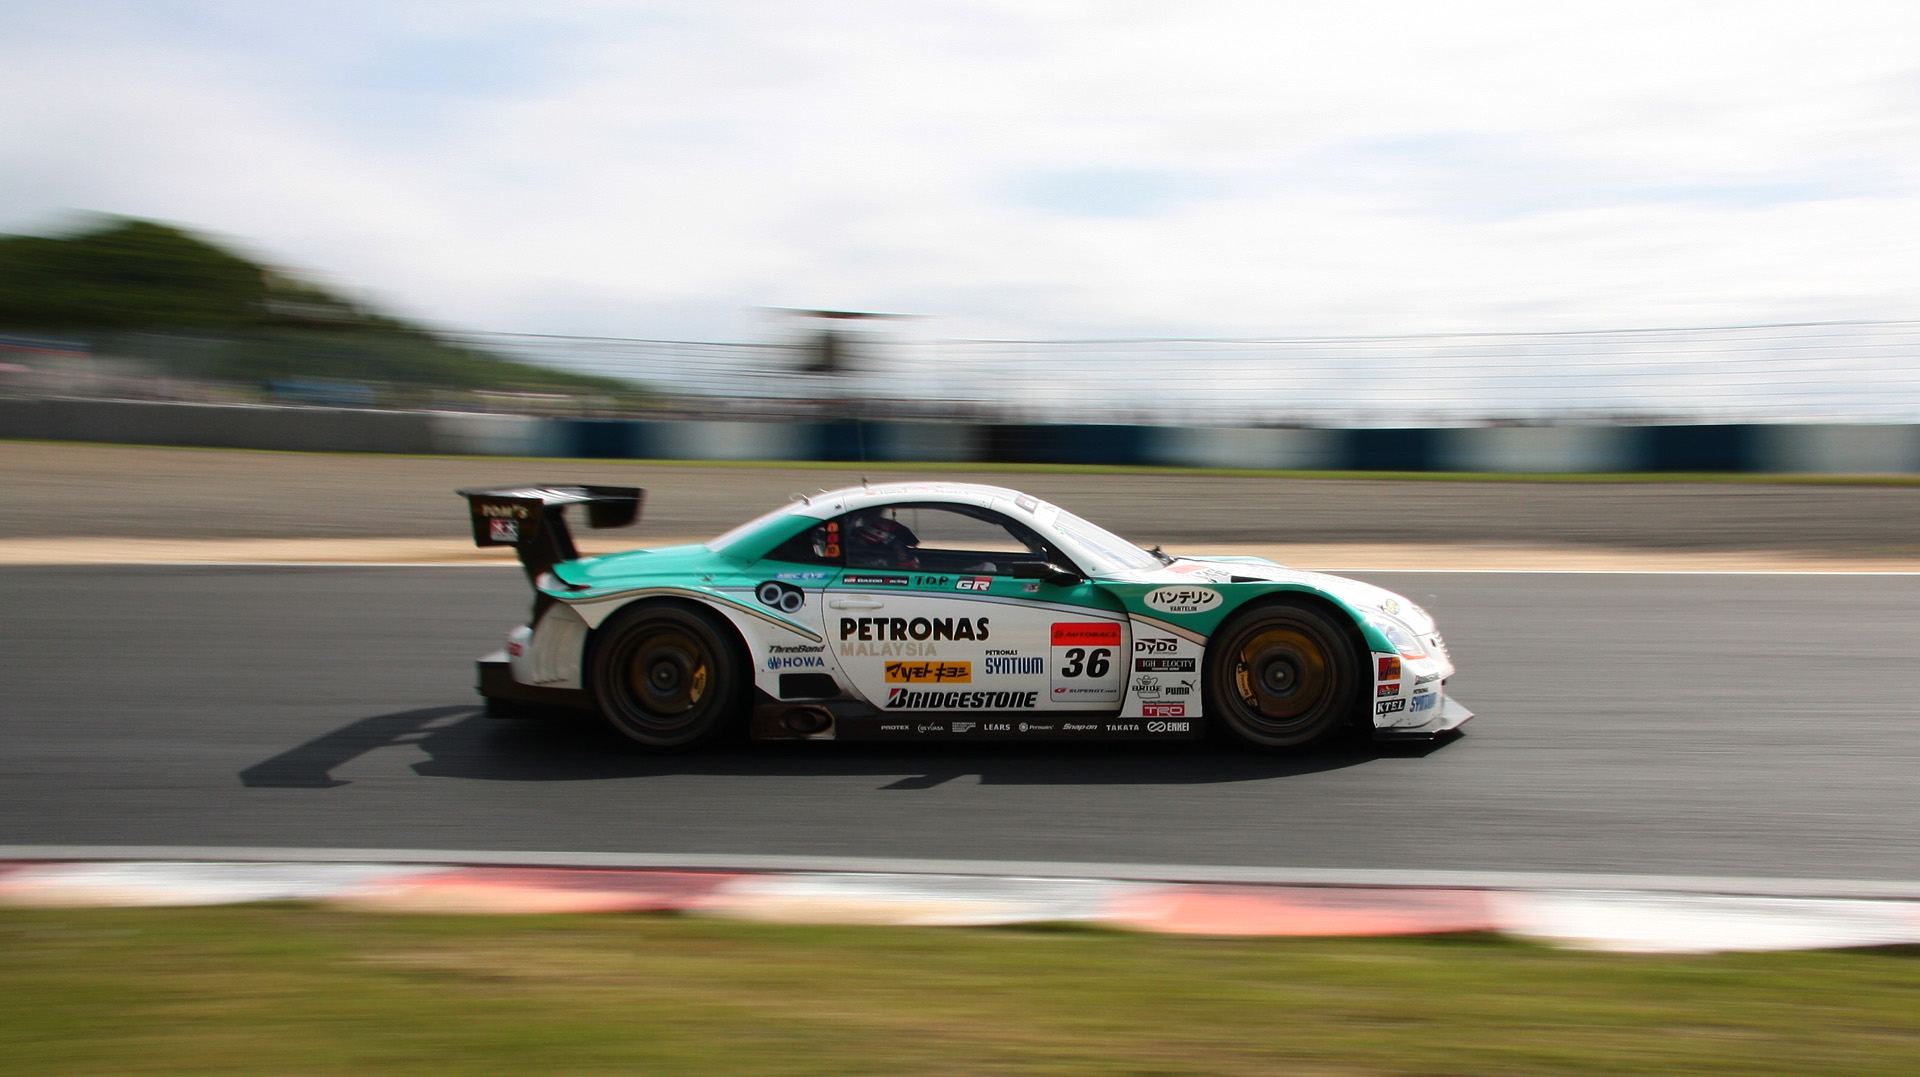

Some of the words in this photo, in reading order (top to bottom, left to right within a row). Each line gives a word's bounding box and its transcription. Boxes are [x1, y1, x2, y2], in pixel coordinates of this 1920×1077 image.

[956, 580, 990, 591] GR
[1152, 591, 1215, 605] バンテリン
[840, 617, 990, 641] PETRONAS
[769, 645, 826, 653] ThreeBond
[840, 643, 938, 657] MALAYSIA
[1135, 639, 1178, 655] DyDo
[783, 657, 825, 667] HOWA
[985, 657, 1043, 675] SYNTIUM
[1061, 648, 1112, 678] 36
[1137, 660, 1156, 668] IGH
[1158, 660, 1193, 668] ELOCITY
[886, 663, 969, 682] マツモトキヨシ
[1165, 687, 1190, 695] PUMA
[885, 688, 1038, 709] BRIDGESTONE
[1144, 706, 1183, 717] TRD
[1377, 701, 1404, 714] KTEL
[1106, 724, 1140, 732] TAKATA
[1167, 722, 1190, 732] ENKEI
